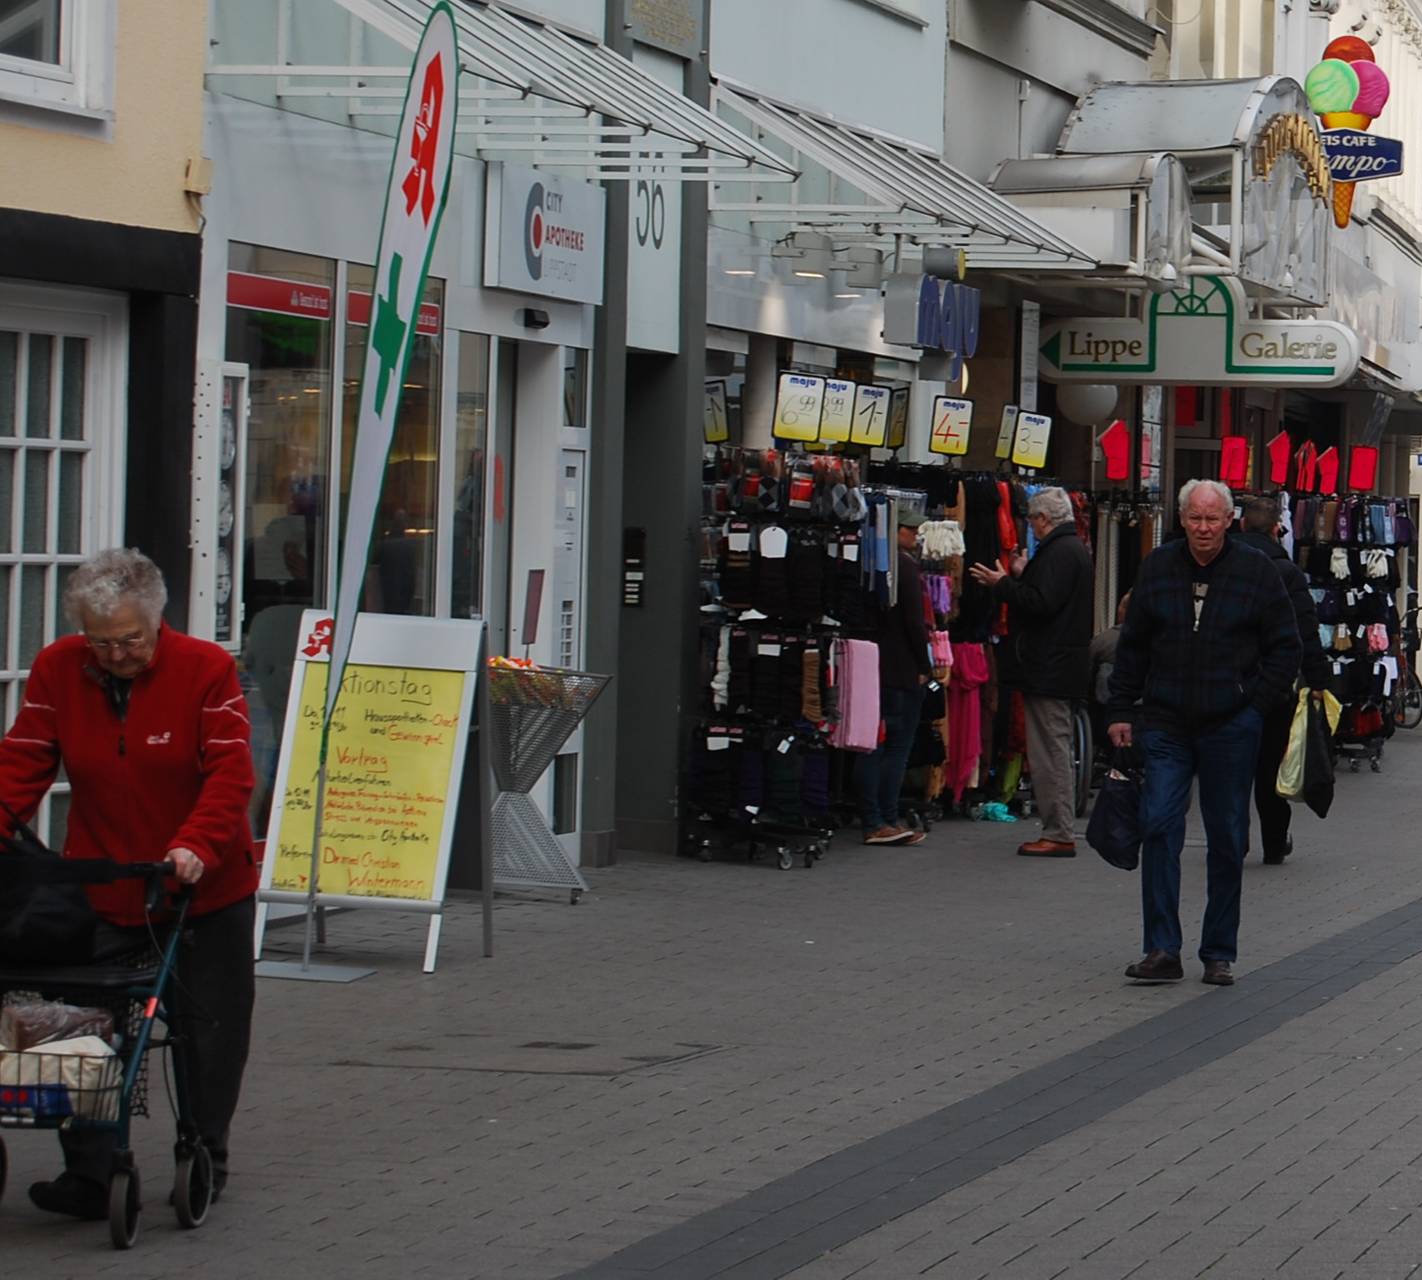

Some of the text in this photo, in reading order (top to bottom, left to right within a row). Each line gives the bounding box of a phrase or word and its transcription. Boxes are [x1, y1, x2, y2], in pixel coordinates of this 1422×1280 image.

[1342, 135, 1377, 147] CAFE
[546, 191, 564, 213] CITY
[545, 224, 585, 252] APOTHEKE
[1068, 331, 1143, 363] Lippe
[1239, 332, 1338, 360] Galerie
[789, 376, 817, 388] maju
[862, 388, 885, 398] maju
[943, 401, 966, 411] maju
[336, 745, 388, 773] Vortrag
